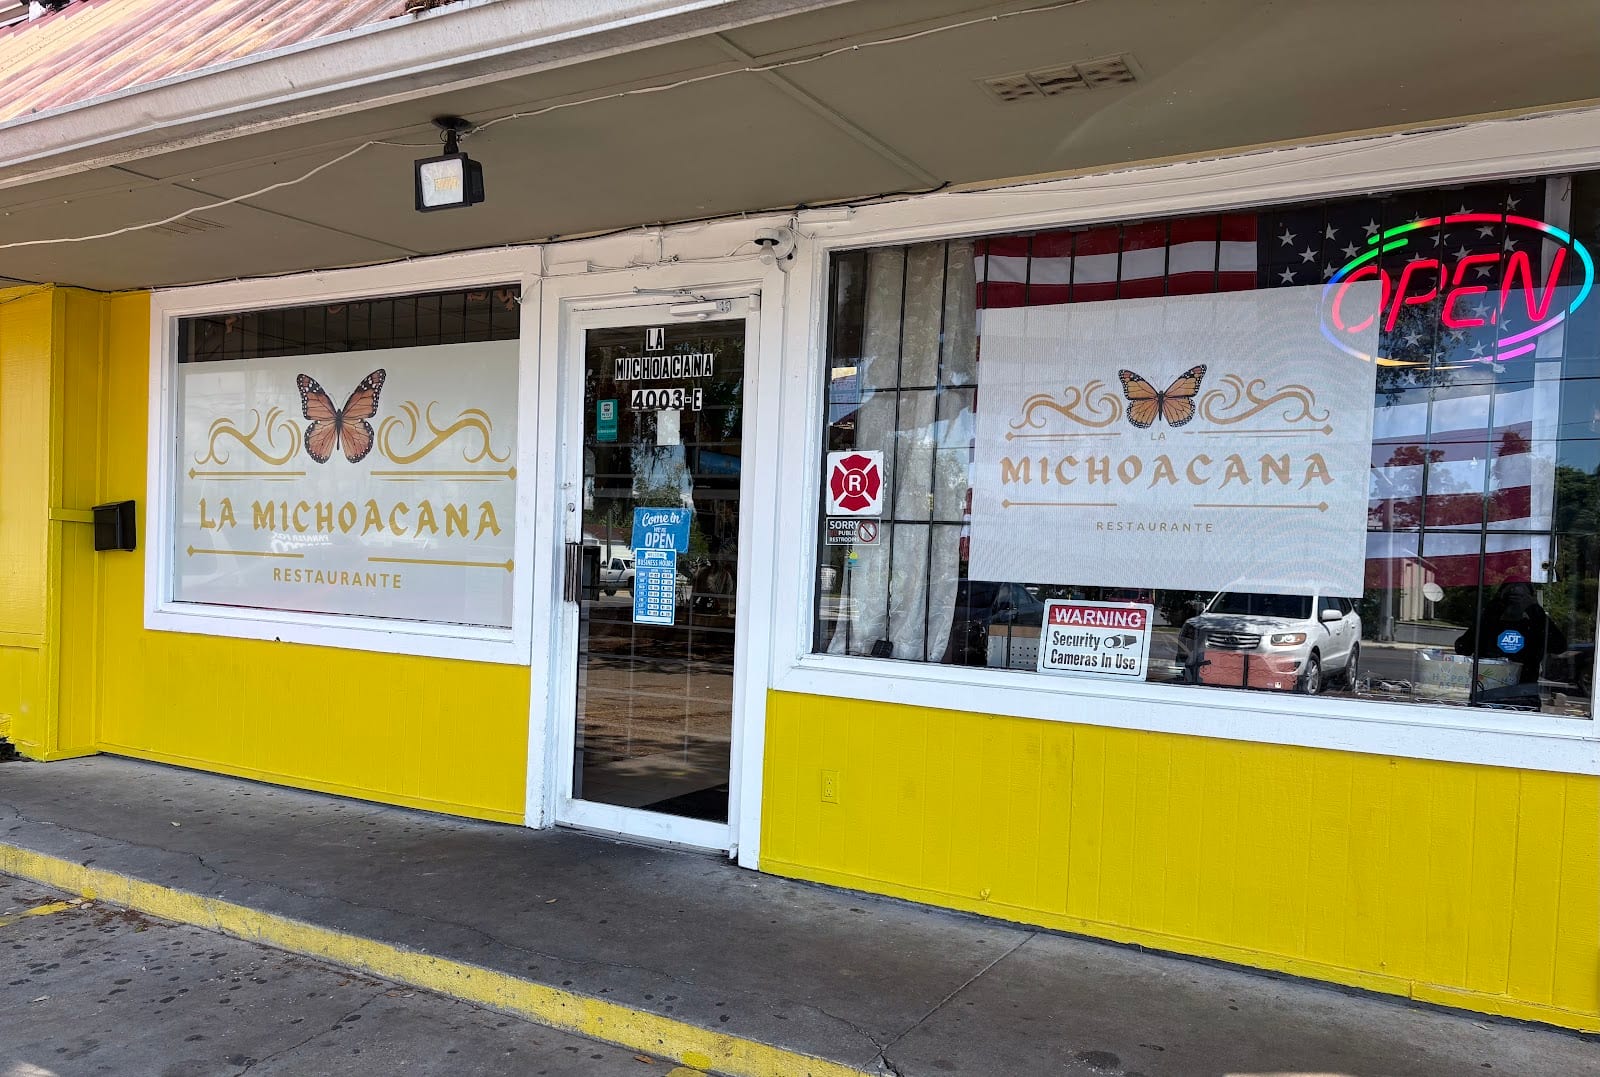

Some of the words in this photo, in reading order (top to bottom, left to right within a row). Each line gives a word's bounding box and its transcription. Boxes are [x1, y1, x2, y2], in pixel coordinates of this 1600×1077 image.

[1332, 247, 1567, 333] OPEN
[646, 328, 664, 350] LA
[616, 355, 713, 380] MICHOACANA
[632, 388, 702, 411] 4003-E
[1150, 432, 1166, 441] LA
[1000, 453, 1335, 490] MICHOACANA
[848, 475, 861, 492] R
[199, 497, 237, 532] LA
[251, 498, 502, 541] MICHOACANA
[642, 512, 669, 526] Come
[830, 520, 860, 530] SORRY
[1096, 521, 1214, 533] RESTAURANTE
[645, 532, 675, 548] OPEN
[273, 567, 402, 589] RESTAURANTE
[1055, 607, 1141, 628] WARNING
[1052, 630, 1101, 652] Security
[1502, 635, 1521, 643] ADT
[1050, 648, 1098, 667] Cameras
[1115, 653, 1136, 670] Use
